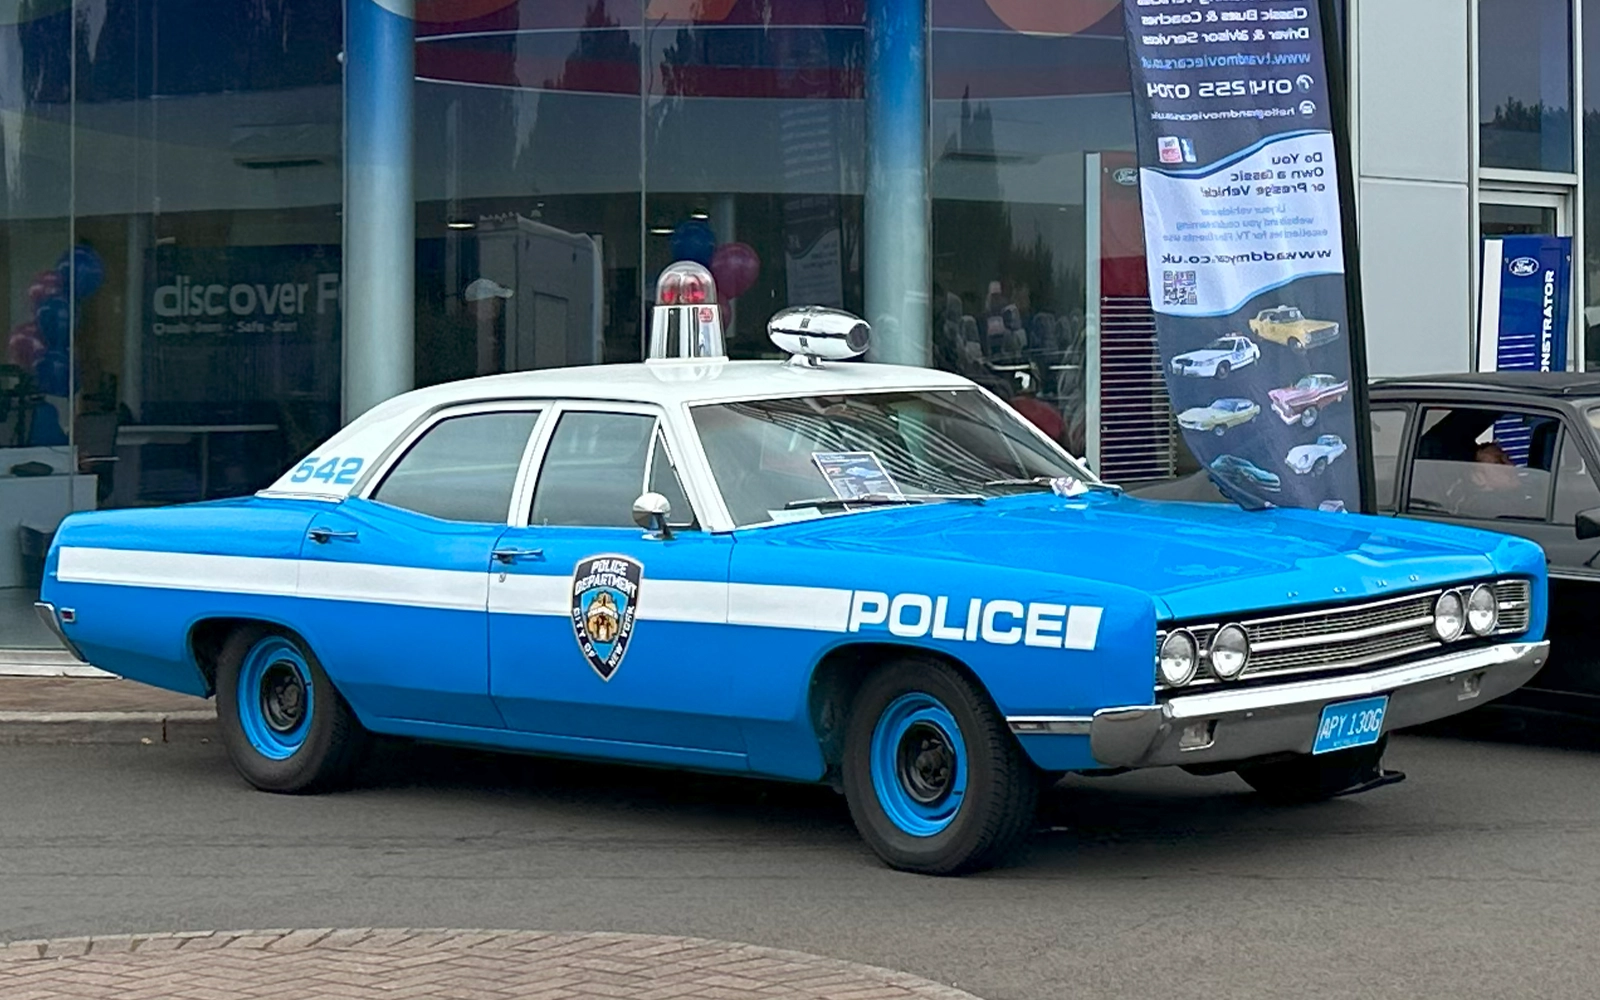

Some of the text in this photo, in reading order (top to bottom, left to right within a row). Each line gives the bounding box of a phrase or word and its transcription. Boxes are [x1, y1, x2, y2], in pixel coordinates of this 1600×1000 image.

[153, 272, 342, 317] discover F
[291, 456, 365, 485] 542
[575, 573, 638, 599] DEPARTMENT
[590, 559, 629, 577] POLICE
[573, 607, 596, 658] CITY OF
[608, 605, 635, 668] NEW YORK
[849, 590, 1067, 648] POLICE
[1319, 713, 1348, 741] APY
[1347, 707, 1383, 736] 130G
